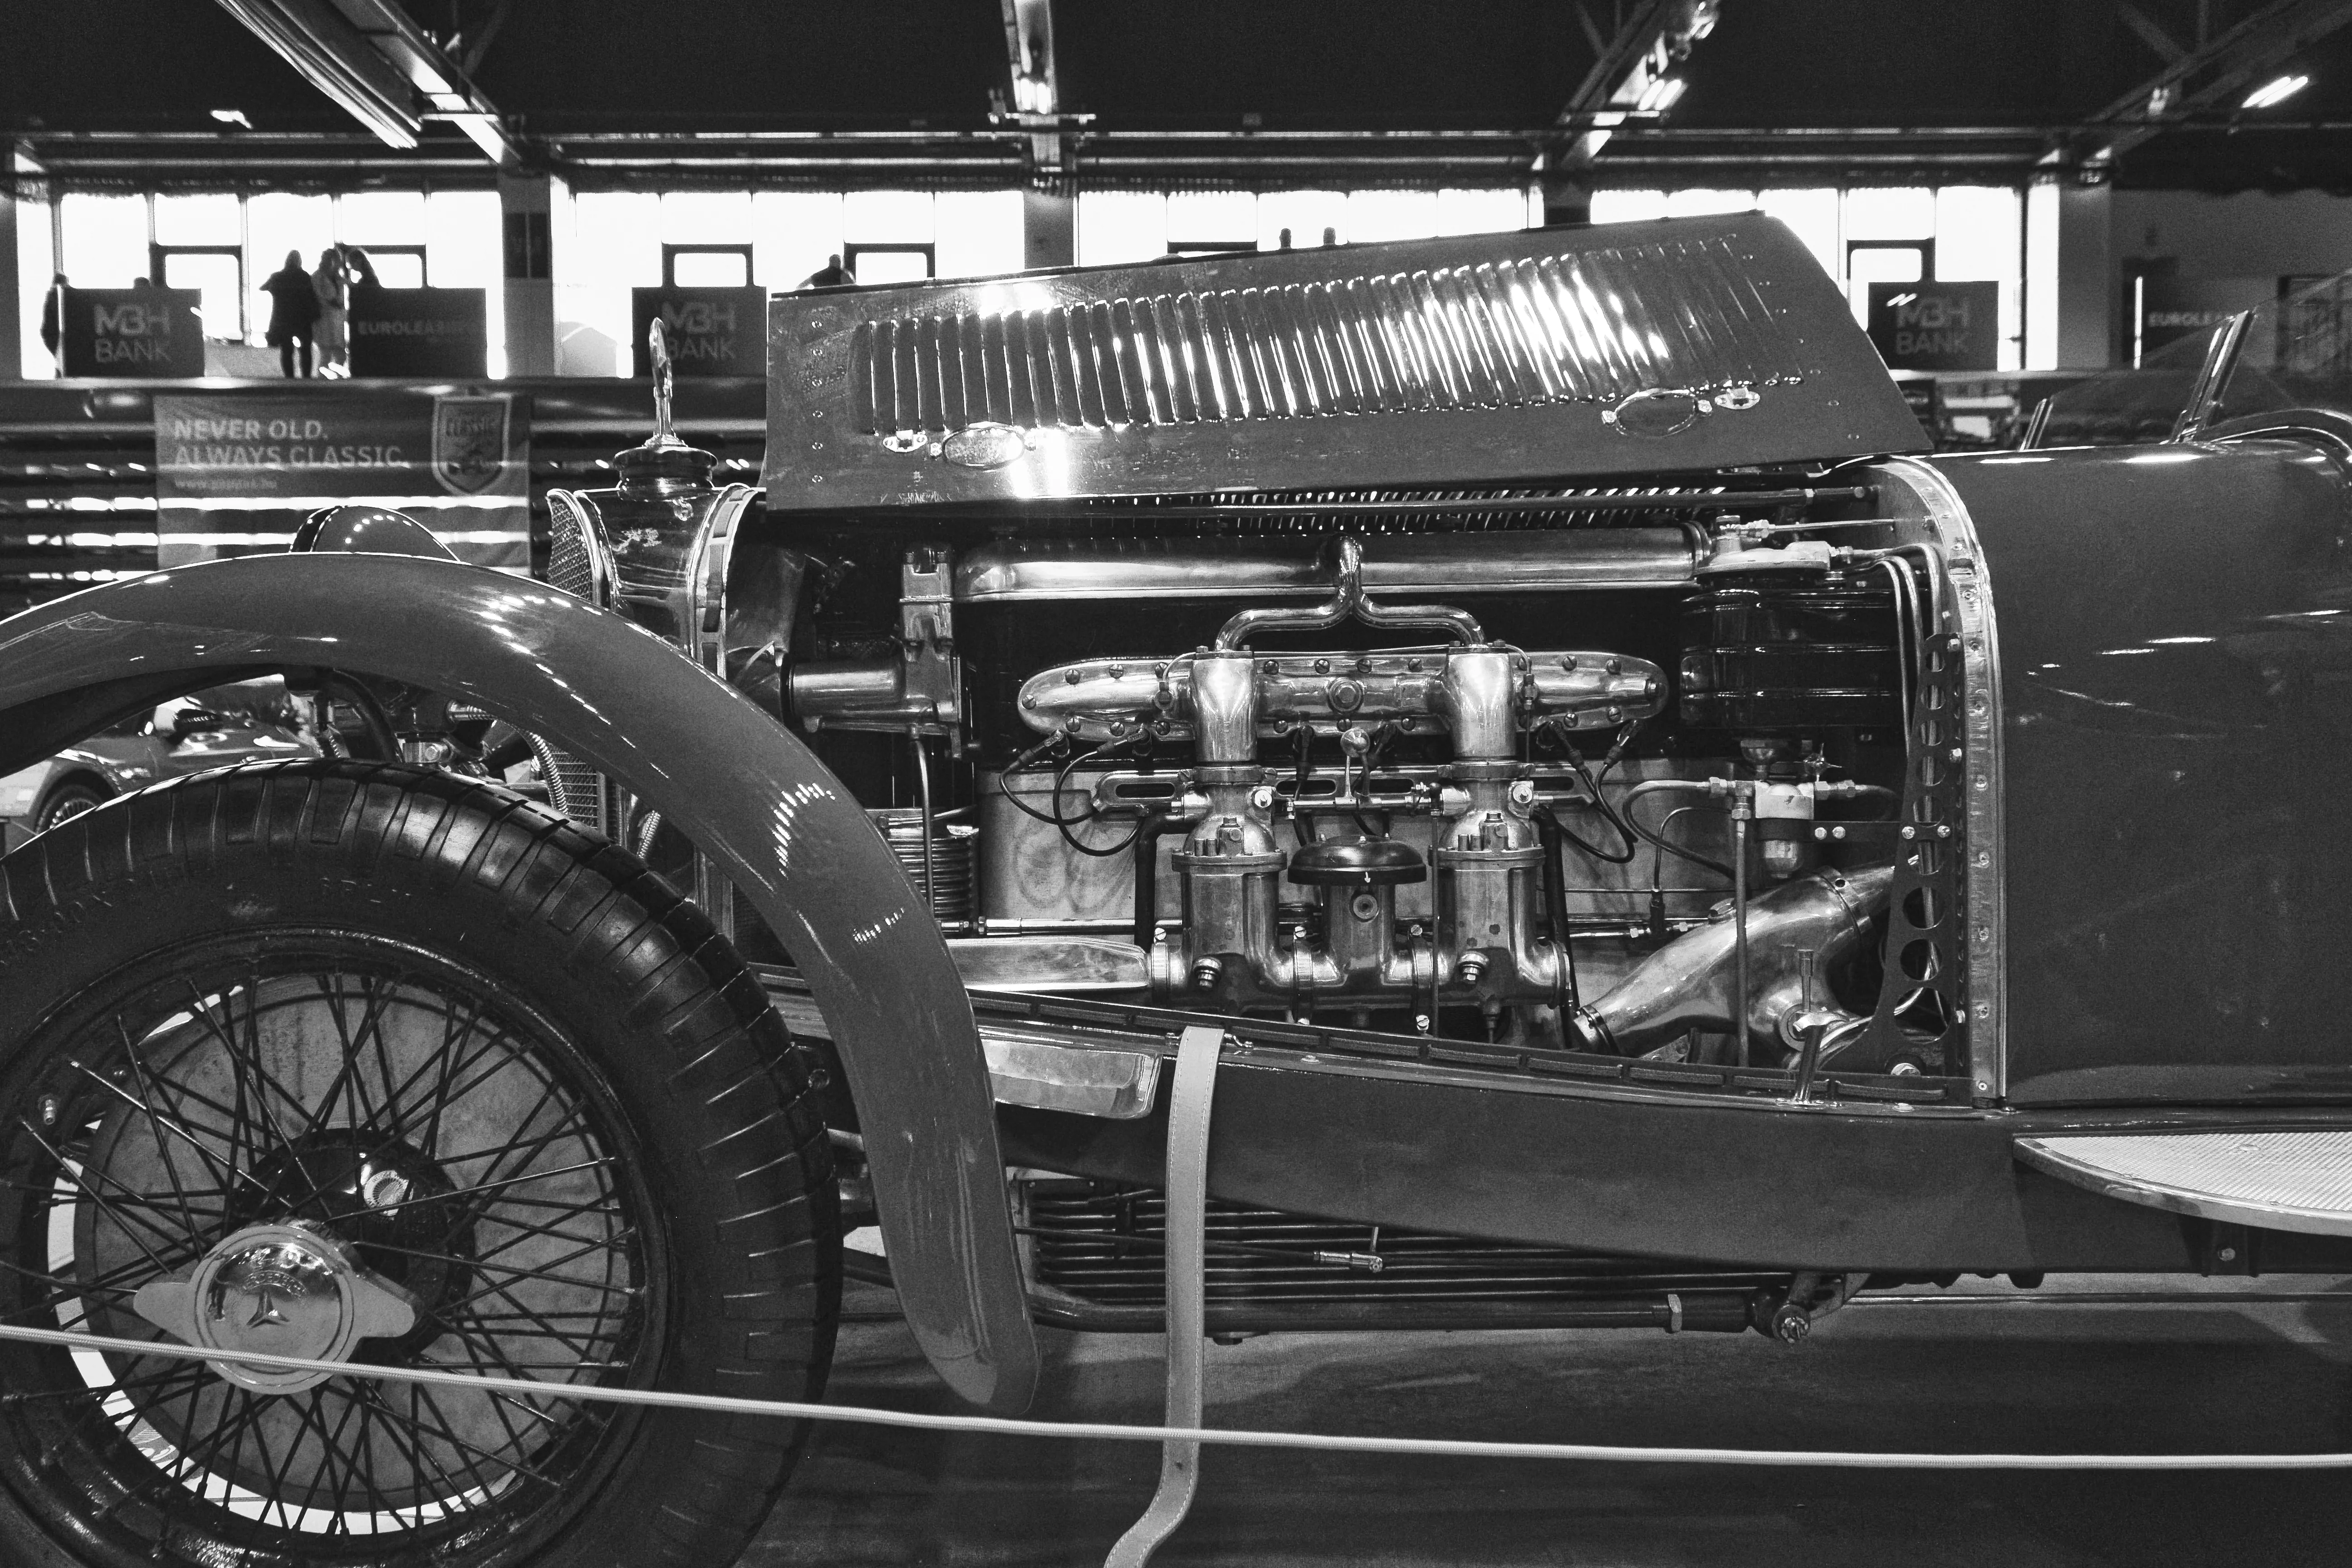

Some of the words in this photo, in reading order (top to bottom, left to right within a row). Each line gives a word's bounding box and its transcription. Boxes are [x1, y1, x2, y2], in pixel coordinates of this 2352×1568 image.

[94, 304, 170, 335] MBH
[662, 302, 735, 334] MBH
[95, 339, 173, 363] BANK
[666, 337, 737, 360] BANK
[1896, 332, 1970, 355] BANK
[174, 419, 260, 440] NEVER
[270, 419, 328, 440] OLD.
[175, 446, 283, 467] ALWAYS
